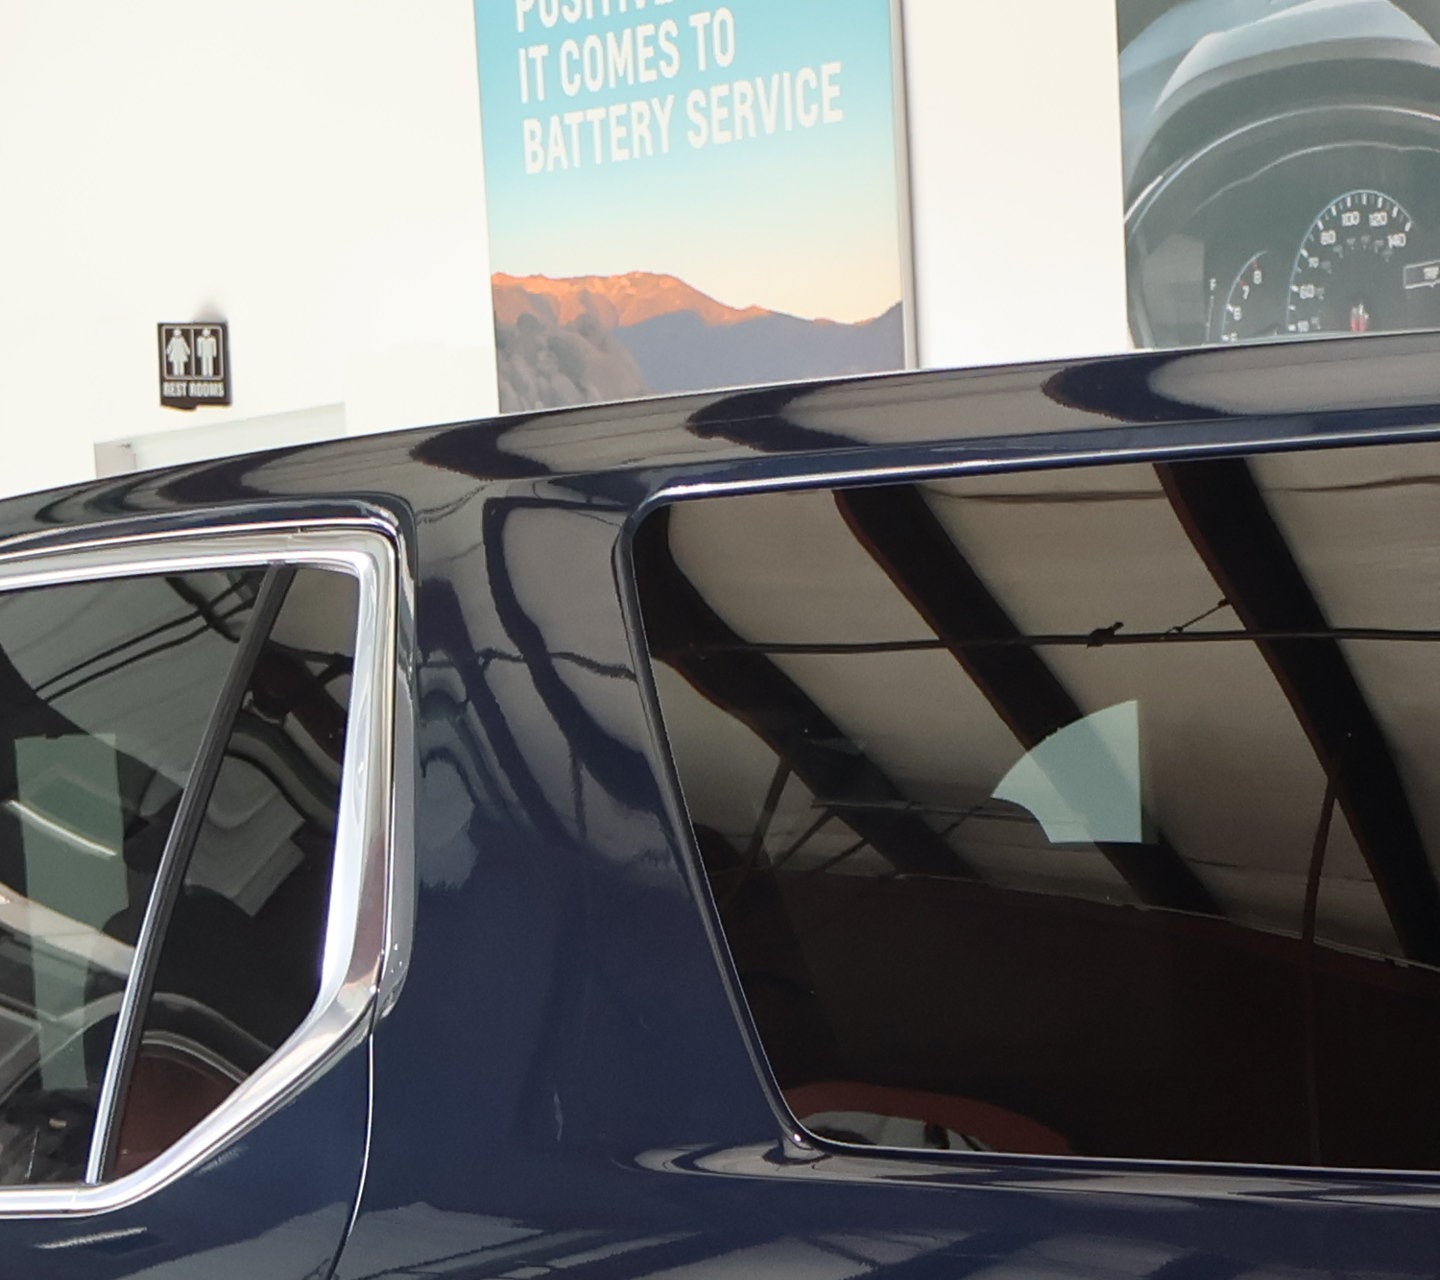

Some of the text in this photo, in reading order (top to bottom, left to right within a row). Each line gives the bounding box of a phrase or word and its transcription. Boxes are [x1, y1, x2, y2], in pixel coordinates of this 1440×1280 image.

[518, 44, 550, 103] IT
[560, 19, 680, 97] COMES
[689, 7, 737, 72] TO
[522, 61, 844, 175] BATTERY SERVICE
